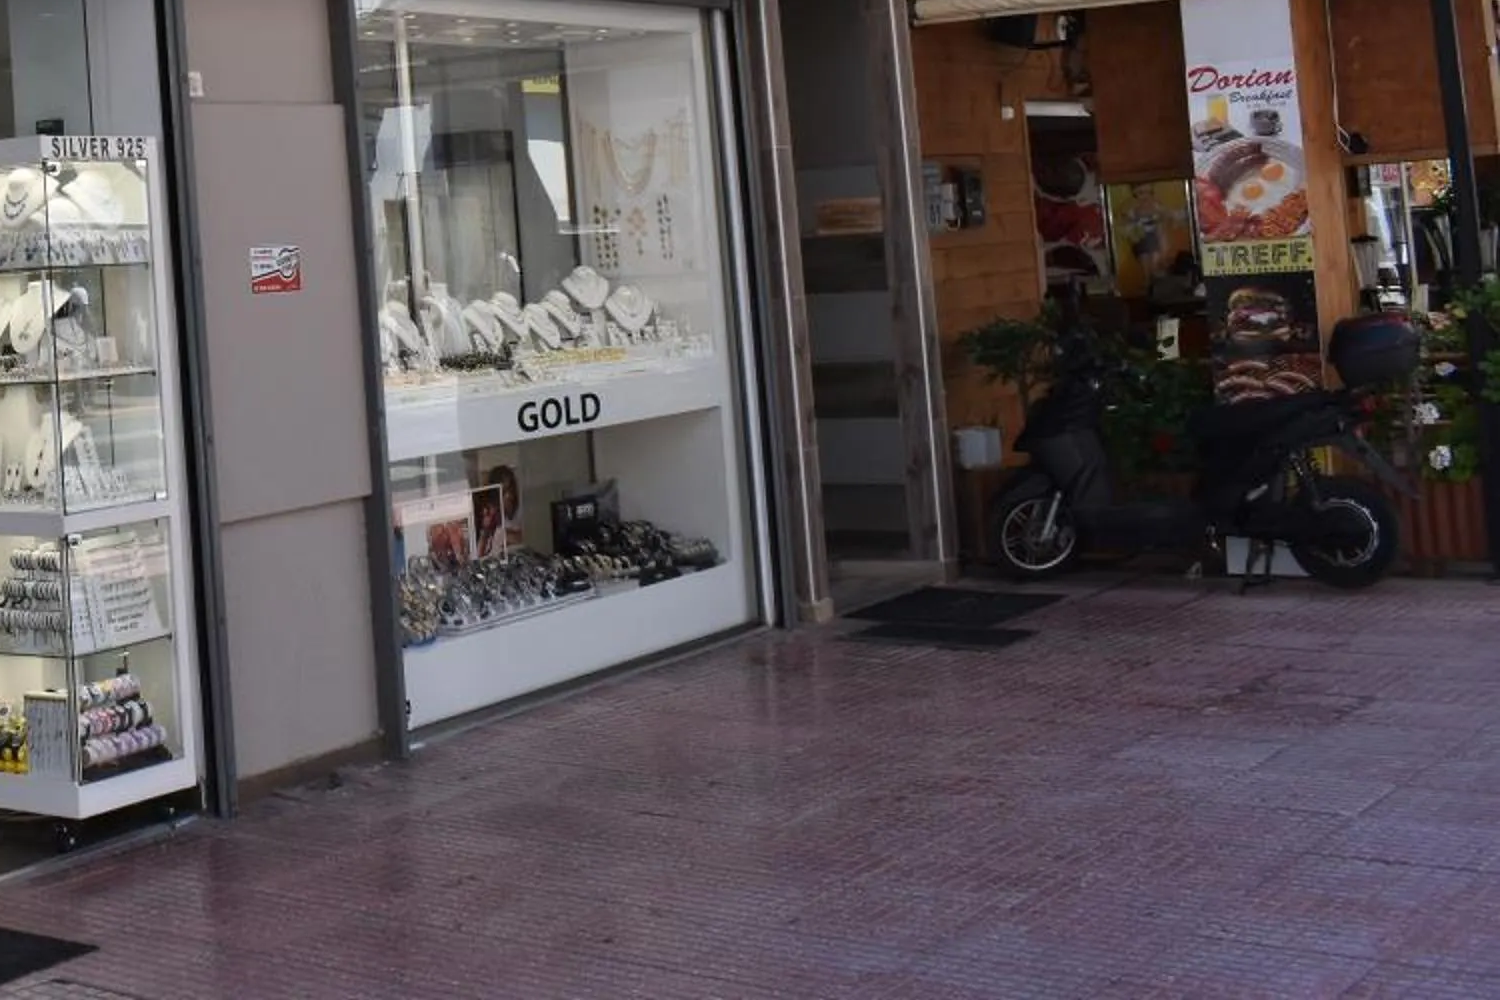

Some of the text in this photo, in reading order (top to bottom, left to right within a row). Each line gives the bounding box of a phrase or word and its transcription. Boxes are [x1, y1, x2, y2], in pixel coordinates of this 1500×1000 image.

[1187, 65, 1293, 93] Dorian
[51, 136, 110, 160] SILVER
[517, 392, 602, 433] GOLD
